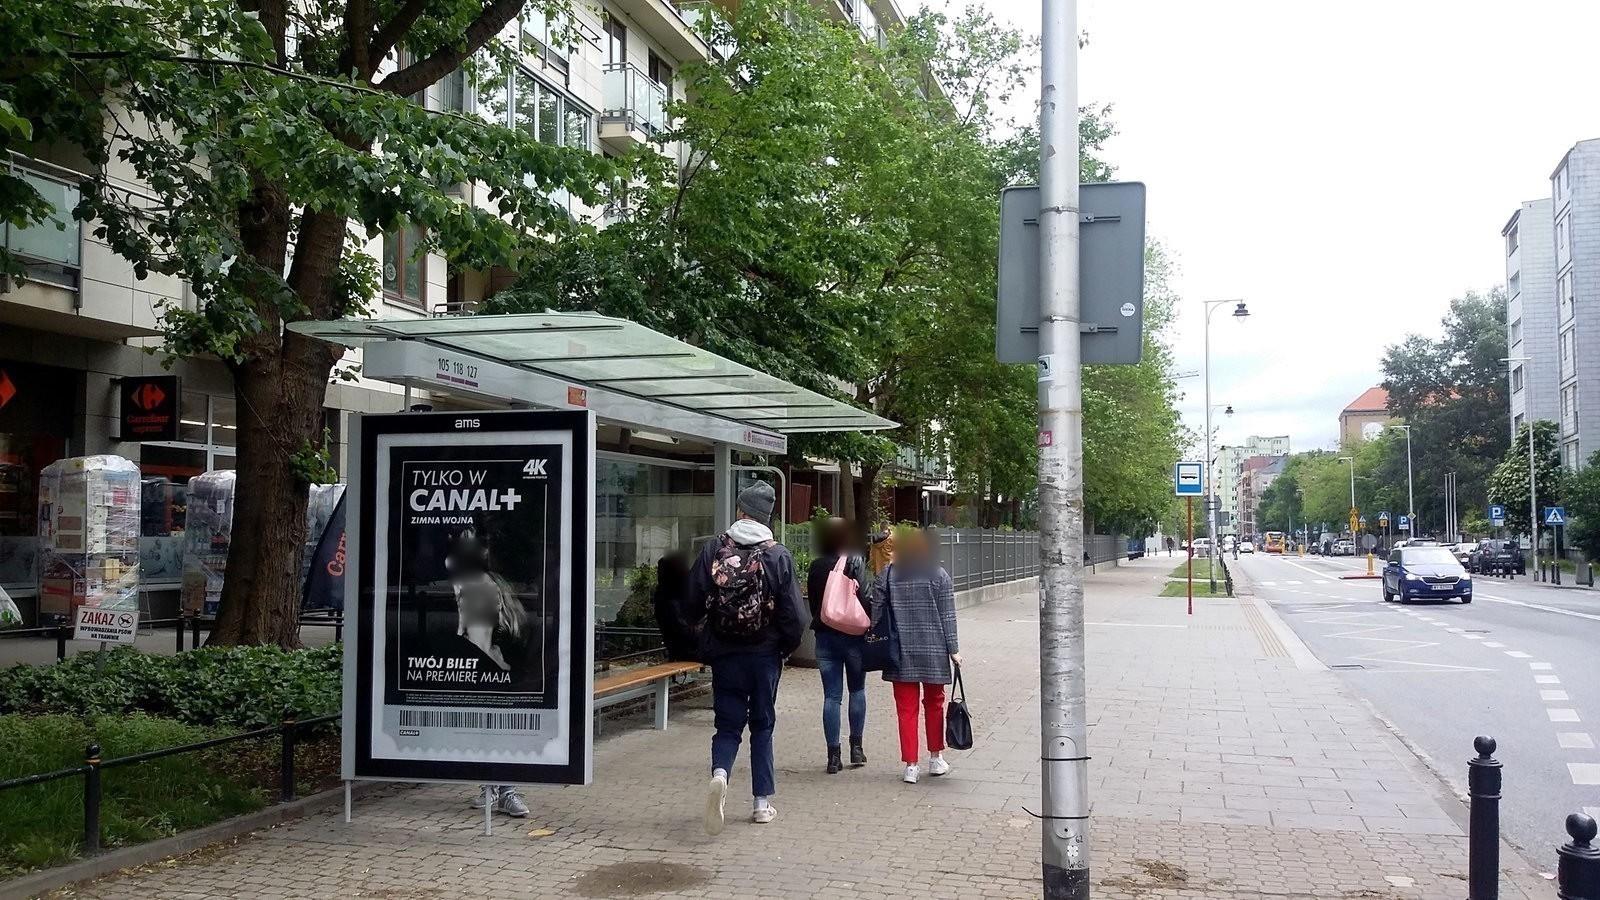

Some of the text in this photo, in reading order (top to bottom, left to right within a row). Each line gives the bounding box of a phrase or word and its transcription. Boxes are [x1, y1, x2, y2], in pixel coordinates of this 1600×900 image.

[438, 358, 478, 379] 105 118 127
[455, 418, 480, 429] ams
[523, 459, 548, 475] 4K
[412, 470, 487, 486] TYLKO W
[409, 488, 522, 511] CANAL+
[411, 516, 474, 524] ZIMNA WOJNA
[1492, 507, 1501, 519] P
[80, 611, 115, 626] ZAKAZ
[408, 655, 479, 669] TWÓJ BILET
[407, 670, 511, 684] NA PREMIERĘ MAJA
